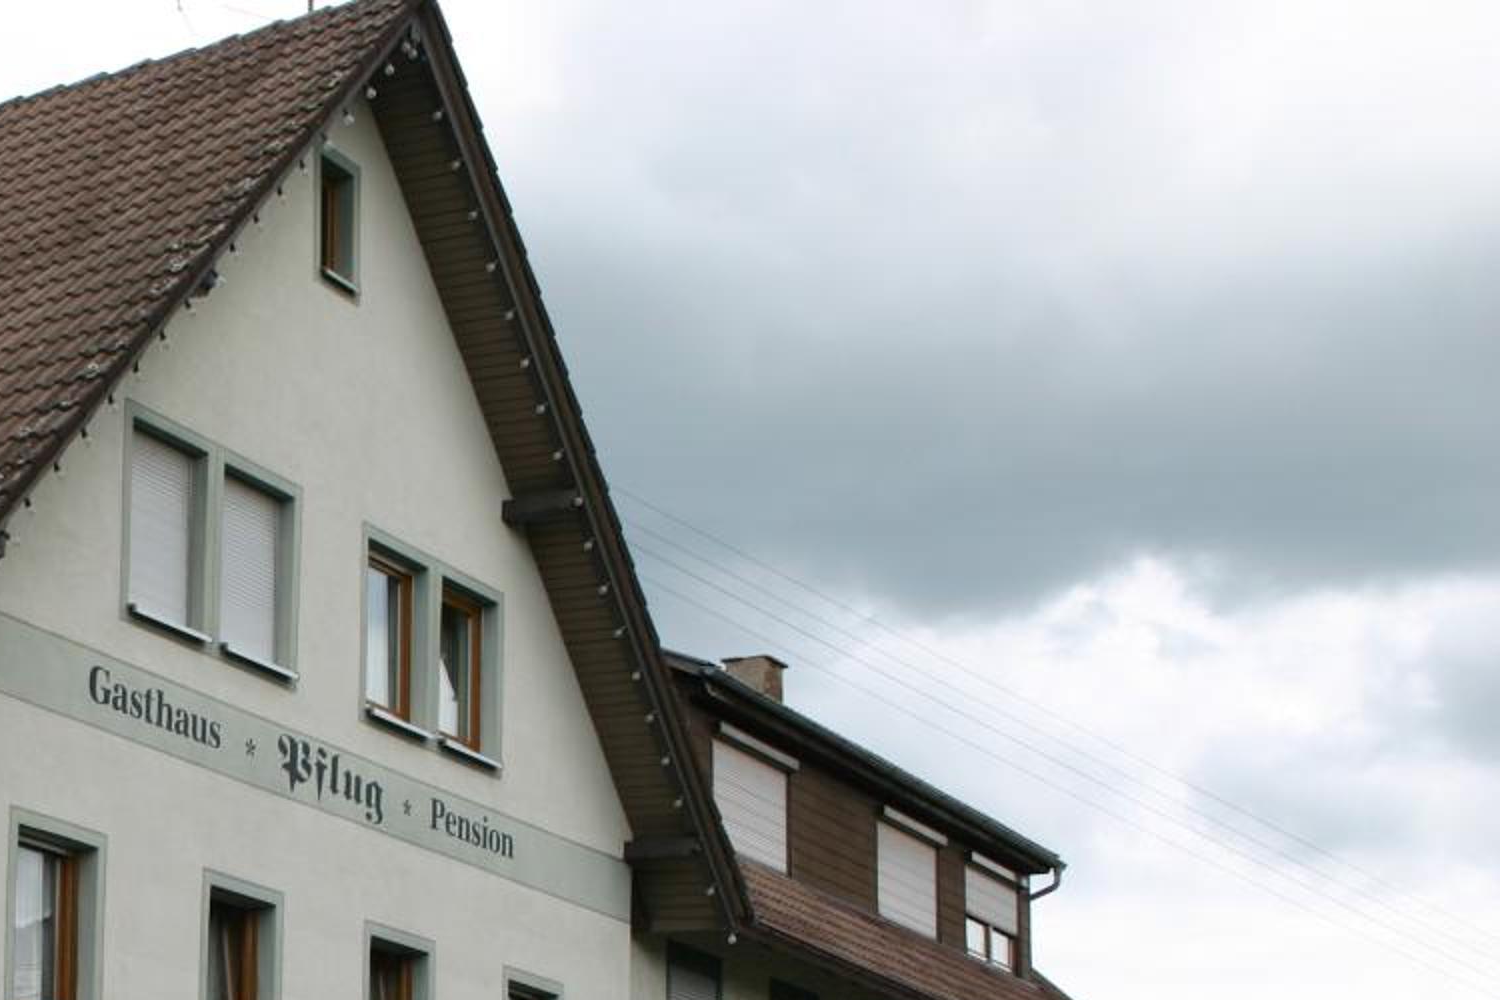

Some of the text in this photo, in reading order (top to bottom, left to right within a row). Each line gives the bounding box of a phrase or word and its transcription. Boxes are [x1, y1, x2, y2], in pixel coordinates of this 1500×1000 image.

[88, 664, 515, 860] Gasthaus Pflug Pension
